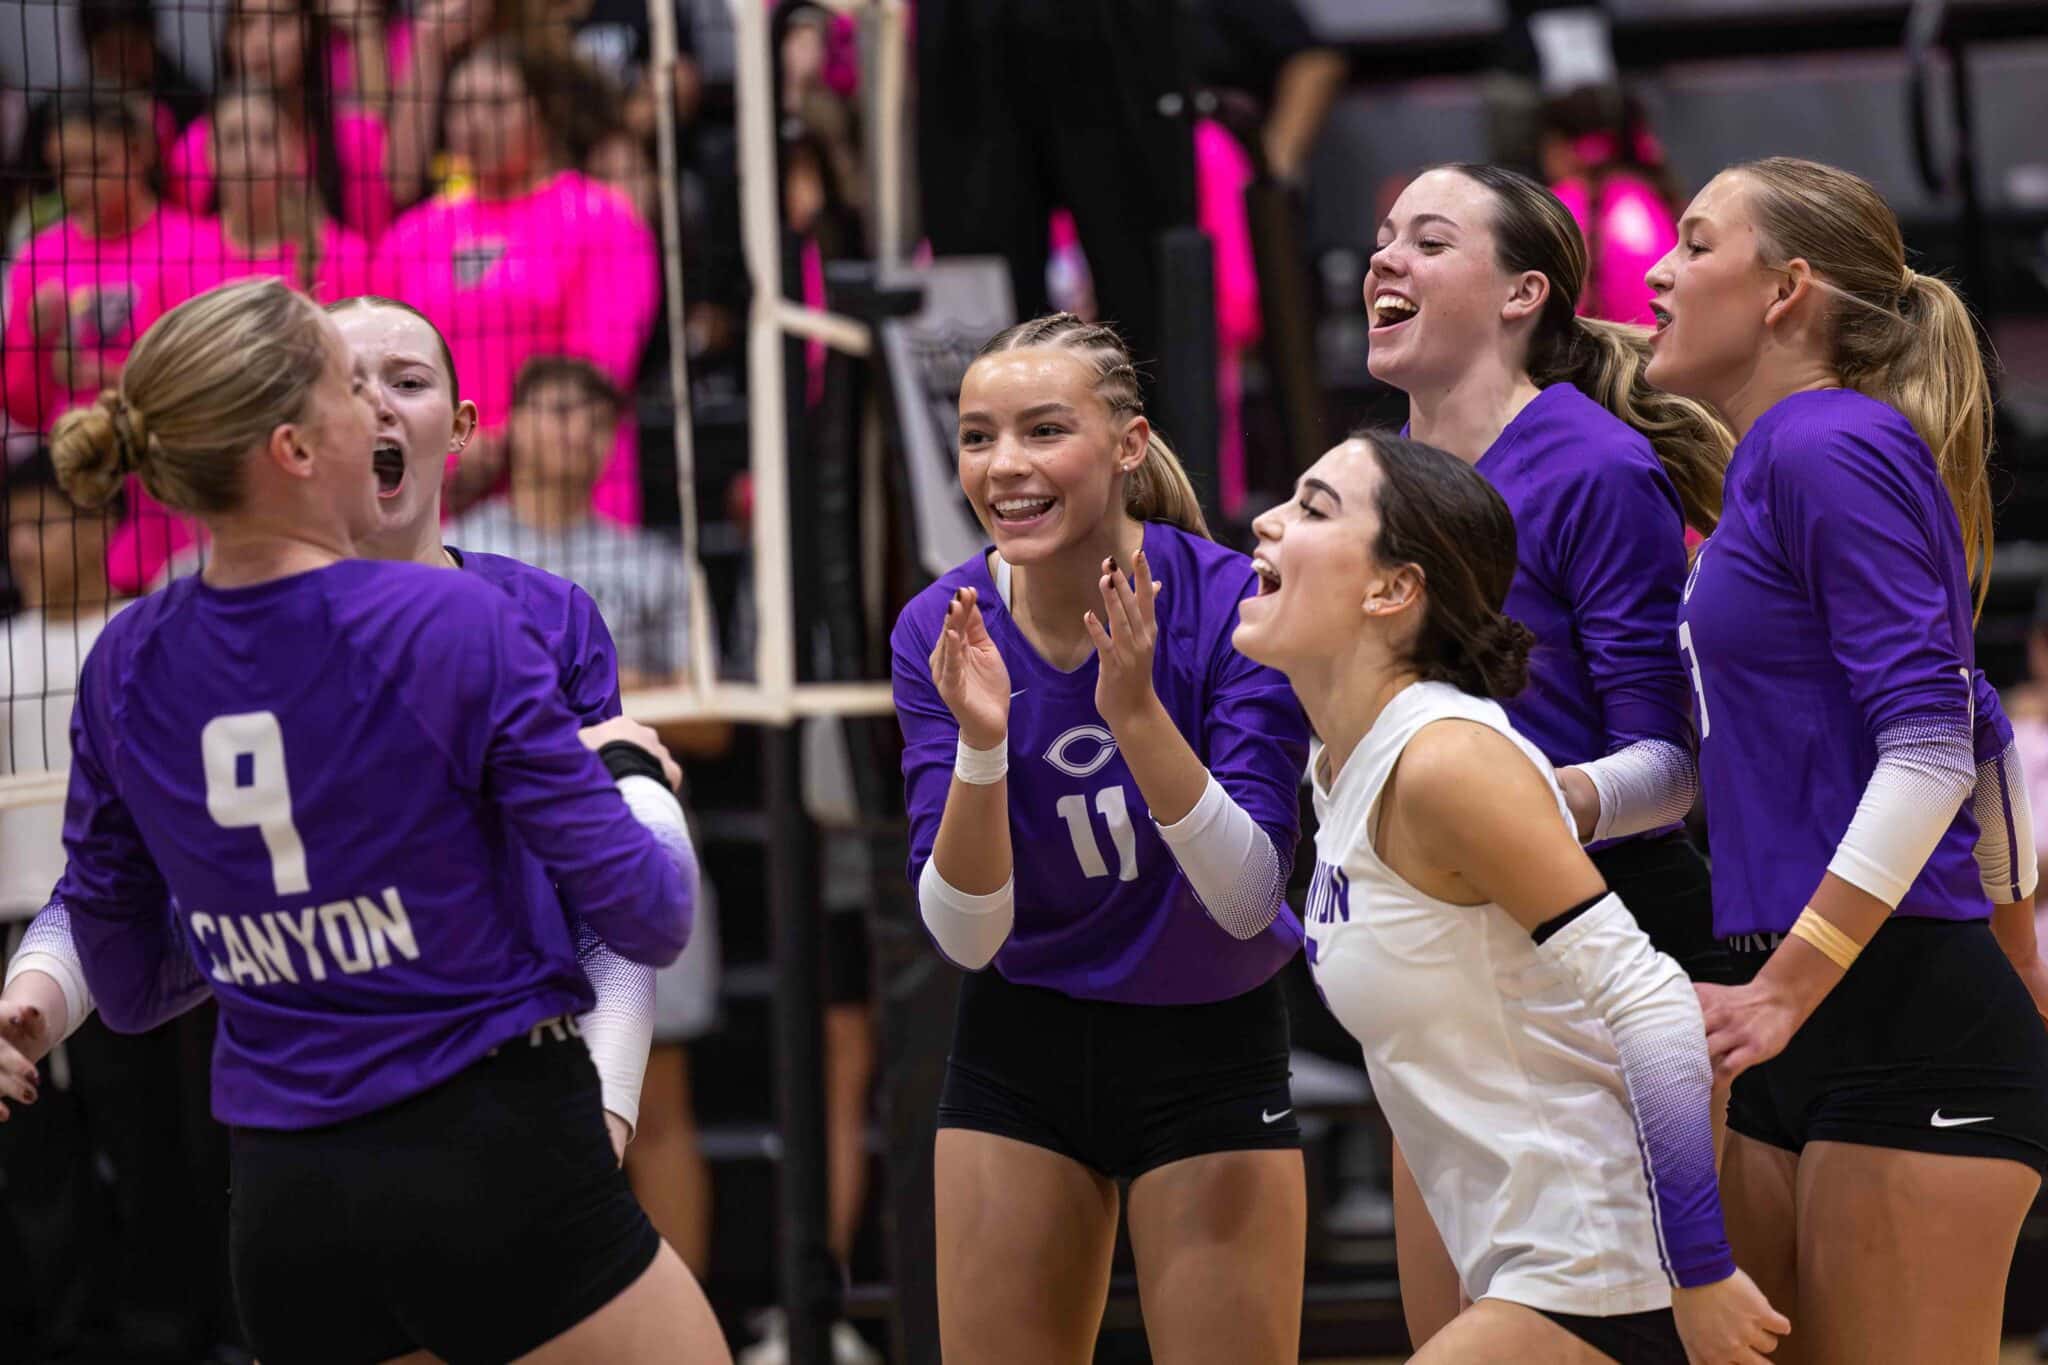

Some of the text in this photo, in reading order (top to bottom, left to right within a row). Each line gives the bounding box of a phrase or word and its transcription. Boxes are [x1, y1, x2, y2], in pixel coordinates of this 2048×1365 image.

[202, 710, 311, 896] 9
[1056, 785, 1139, 882] 11
[191, 886, 420, 986] CANYON
